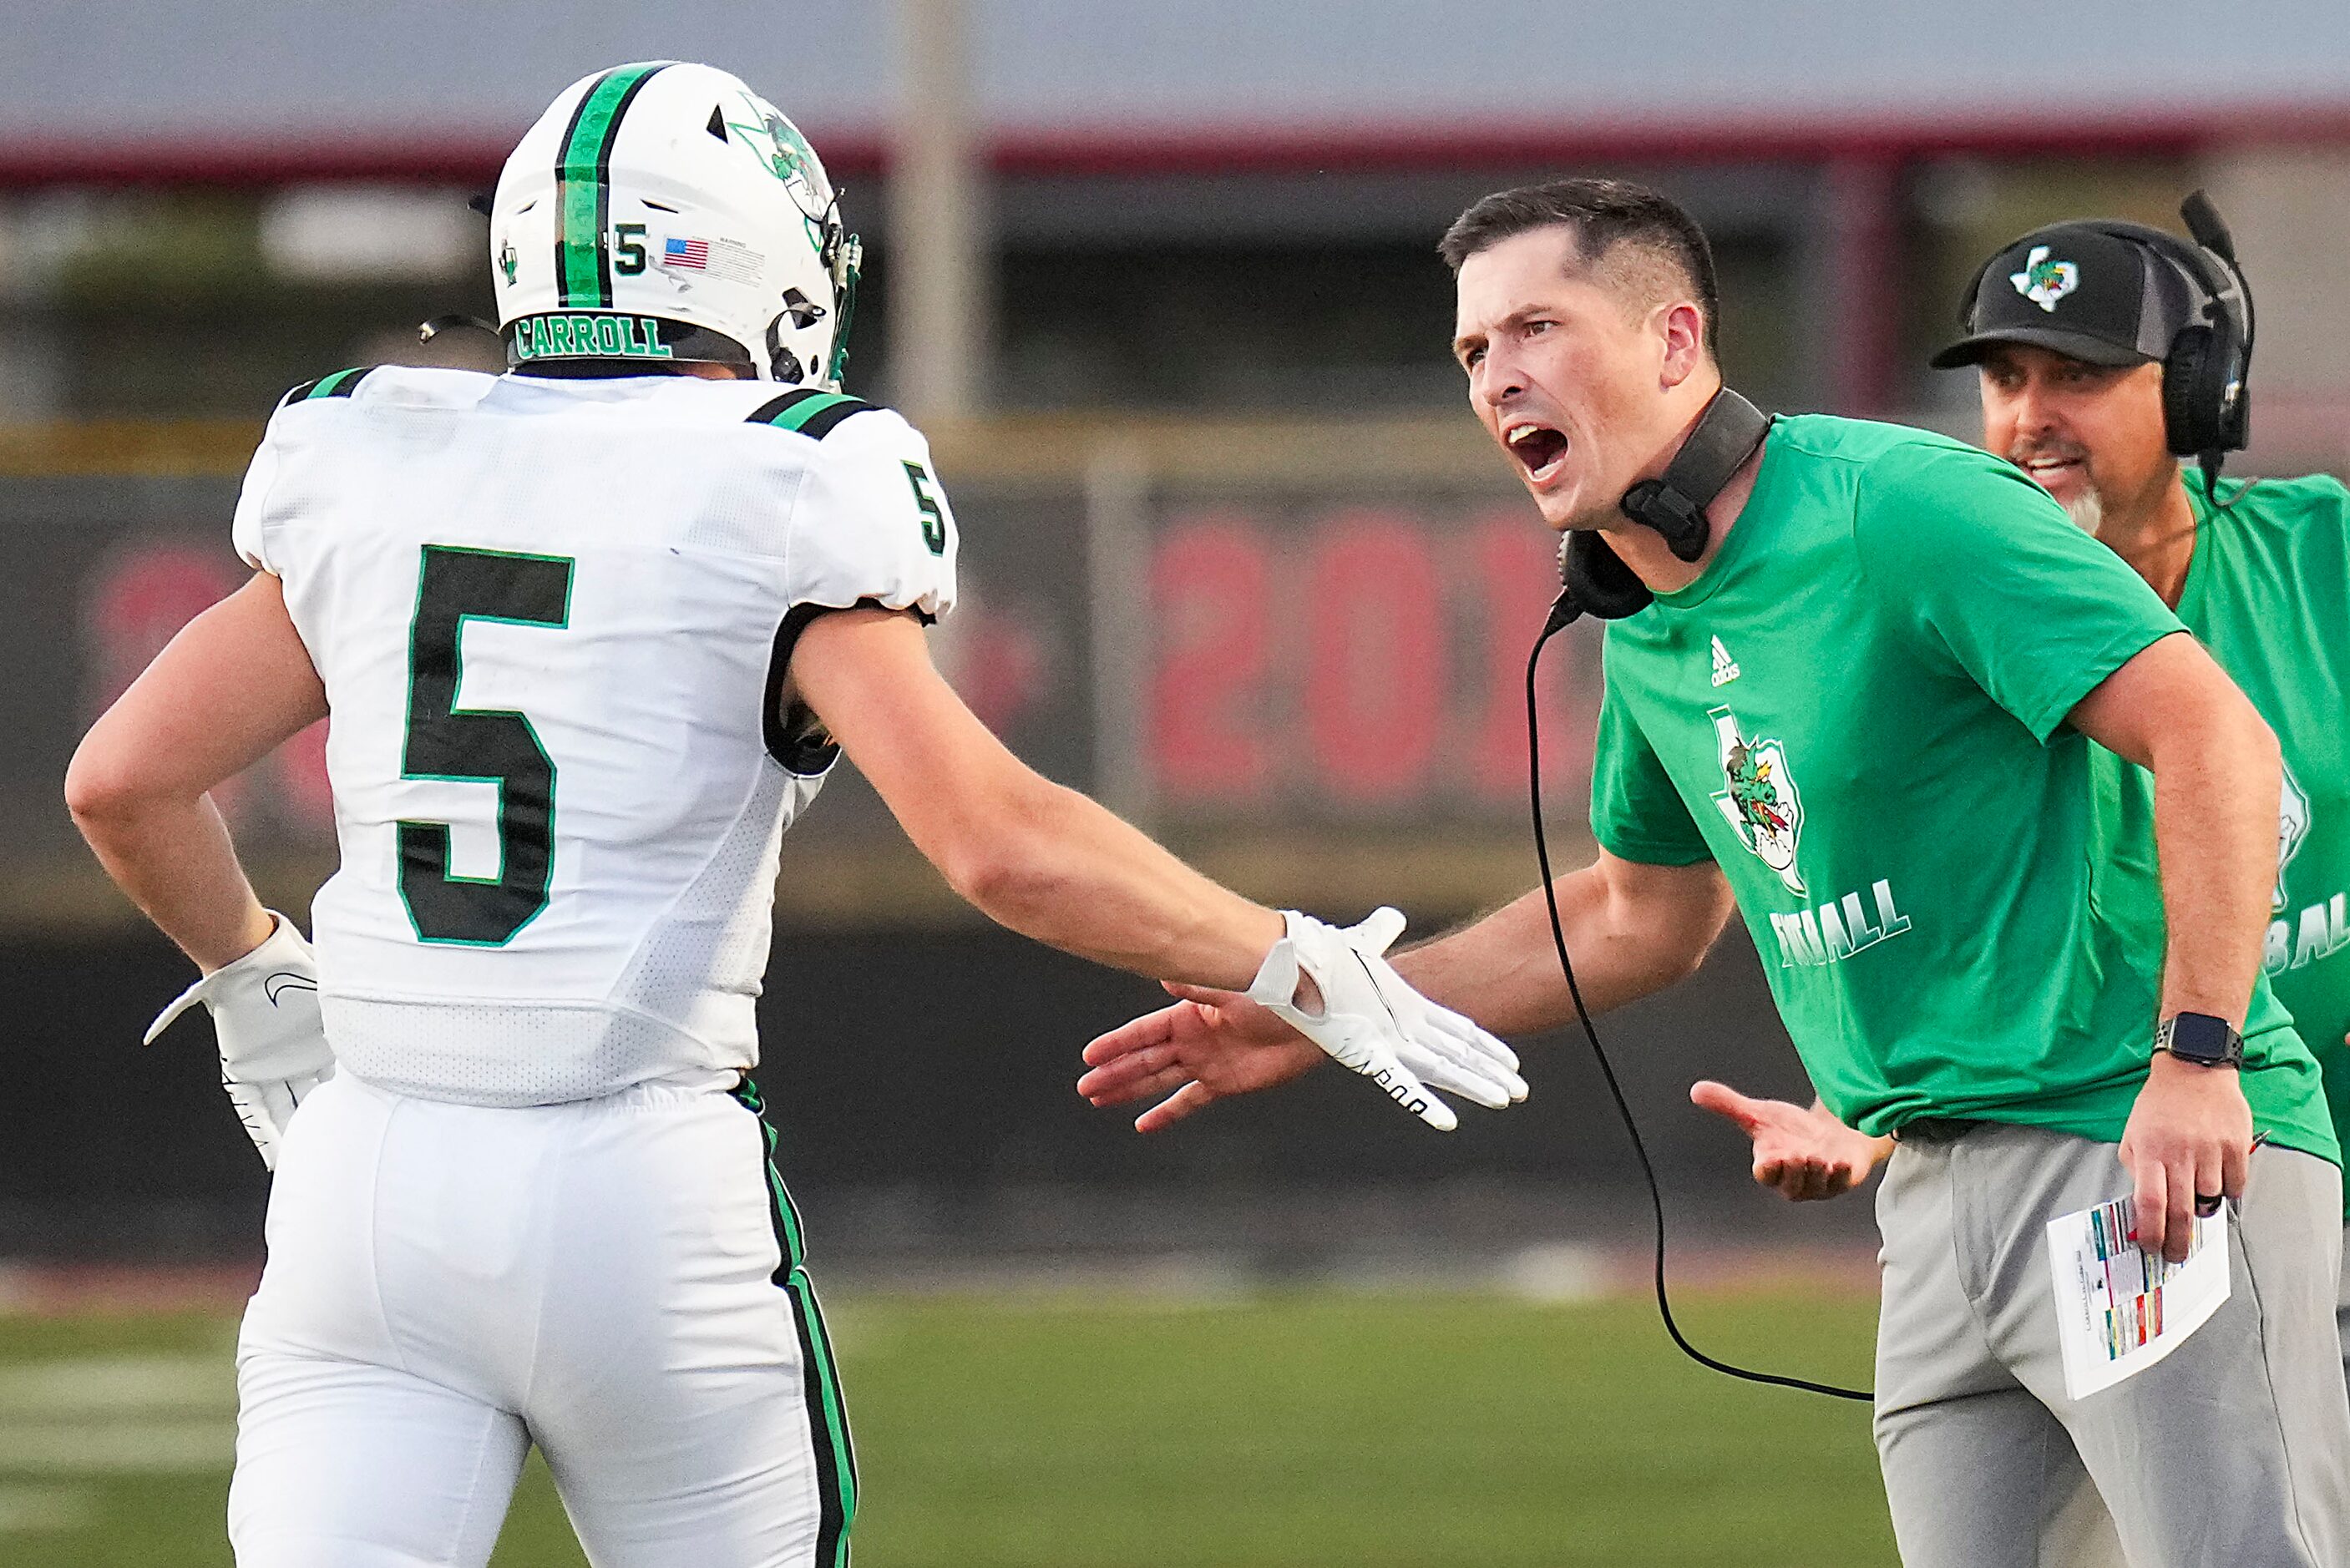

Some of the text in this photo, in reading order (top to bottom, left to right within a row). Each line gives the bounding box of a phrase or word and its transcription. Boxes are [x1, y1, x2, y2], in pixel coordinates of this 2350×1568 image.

[614, 223, 646, 276] 5
[514, 315, 673, 360] CARROLL
[899, 458, 946, 558] 5
[396, 543, 575, 948] 5
